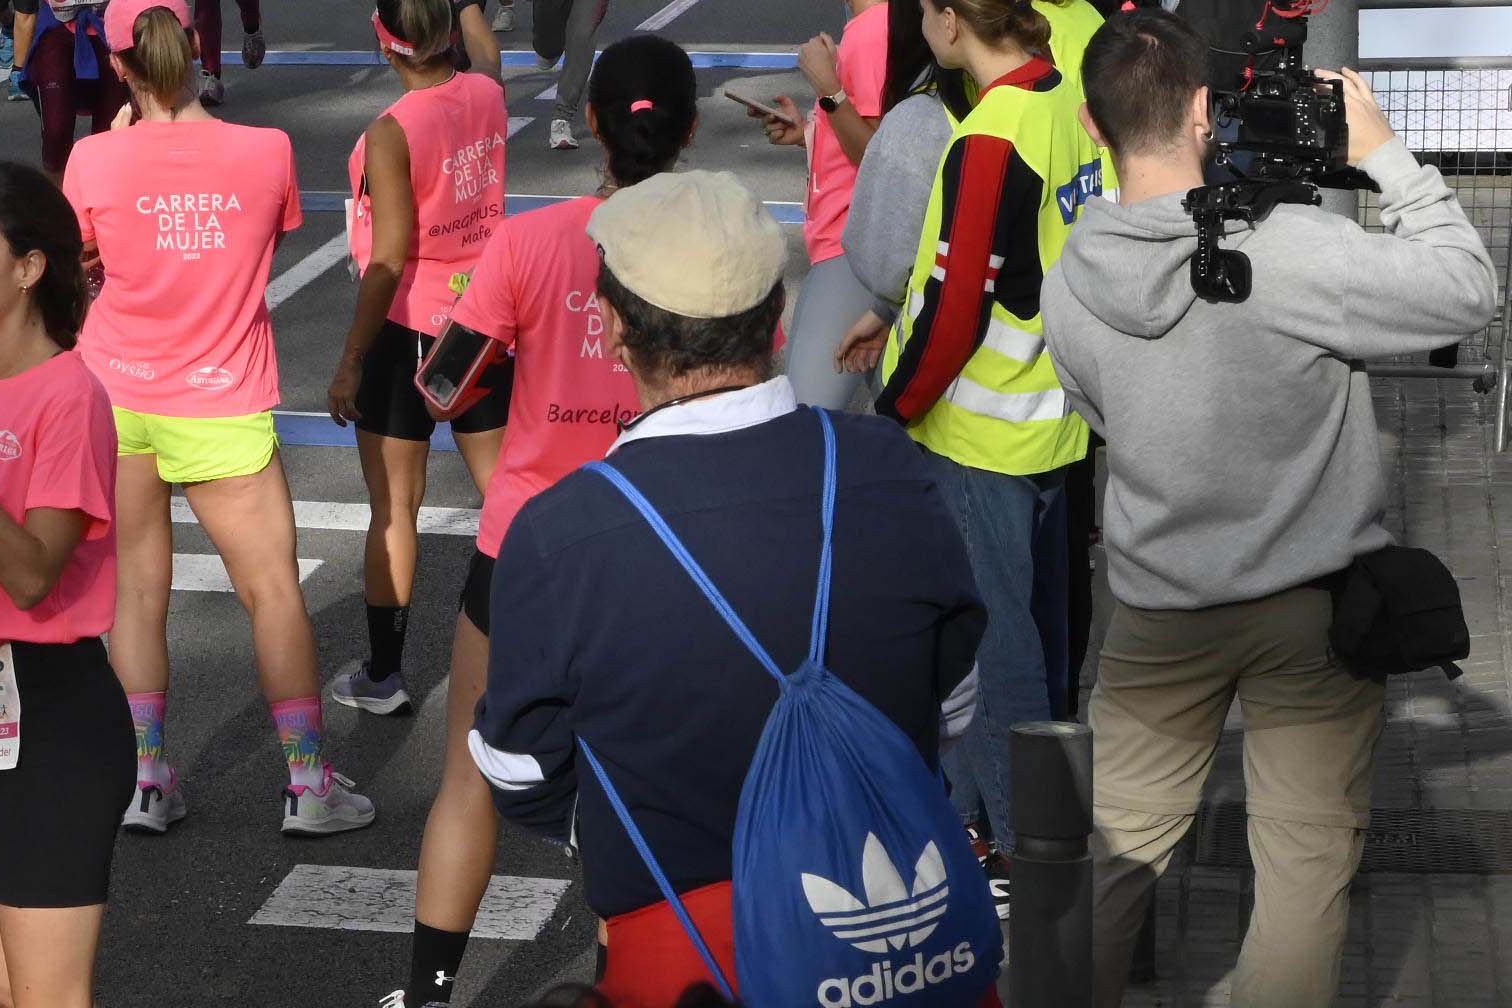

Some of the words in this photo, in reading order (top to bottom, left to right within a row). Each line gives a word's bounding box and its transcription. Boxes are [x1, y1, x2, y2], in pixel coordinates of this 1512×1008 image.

[442, 132, 506, 175] CARRERA
[454, 167, 473, 186] DE
[477, 156, 493, 174] LA
[454, 168, 499, 204] MUJER
[136, 193, 242, 214] CARRERA
[159, 213, 186, 231] DE
[195, 212, 222, 231] LA
[156, 232, 226, 251] MUJER
[109, 358, 155, 380] OYSHO
[817, 941, 975, 1008] adidas
